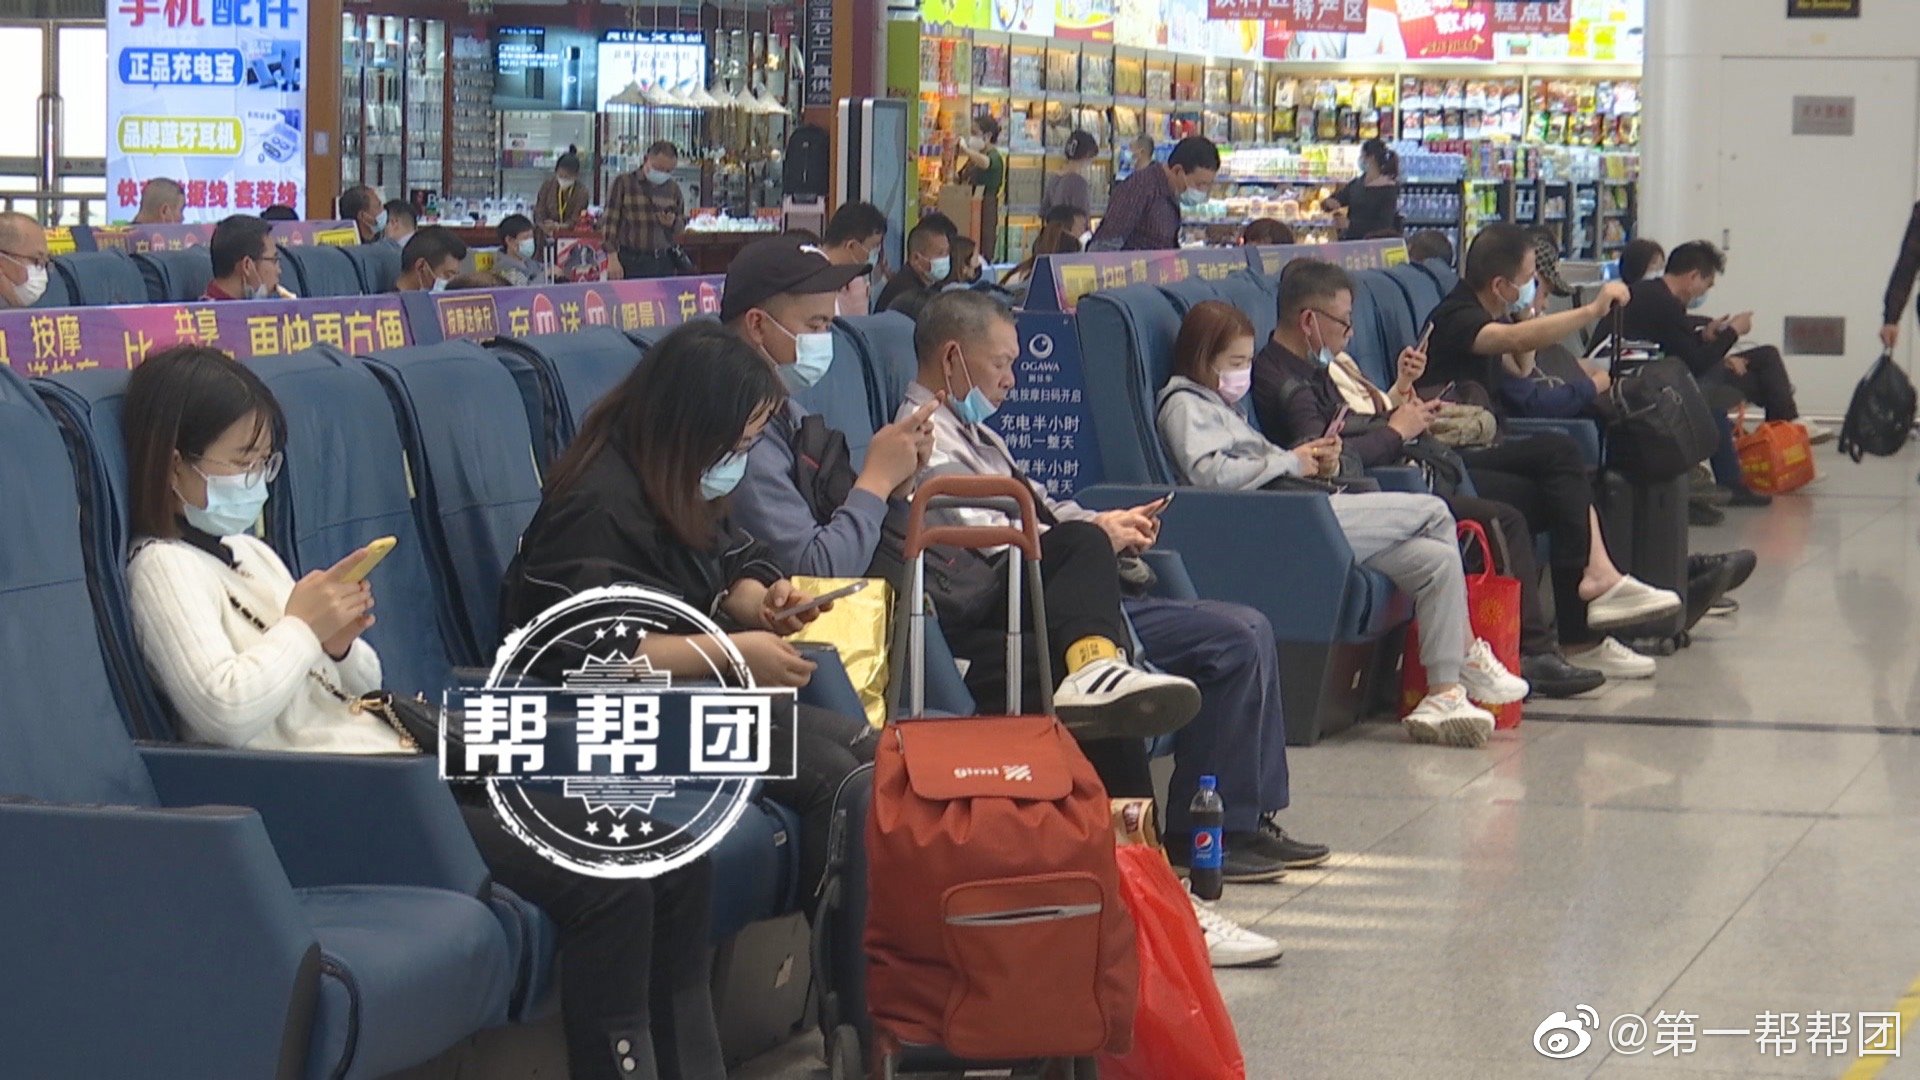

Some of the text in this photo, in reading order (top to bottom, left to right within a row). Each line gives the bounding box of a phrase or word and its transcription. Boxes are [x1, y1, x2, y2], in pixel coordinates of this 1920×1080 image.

[810, 0, 833, 92] 玉石工厂直供
[128, 52, 235, 82] 正品充电宝
[124, 120, 236, 150] 品牌蓝牙耳机
[117, 178, 228, 208] 快据线
[30, 314, 82, 359] 按摩
[1020, 361, 1061, 372] OGAWA
[1001, 413, 1080, 433] 充电半小时
[1006, 433, 1075, 450] 待机一整天
